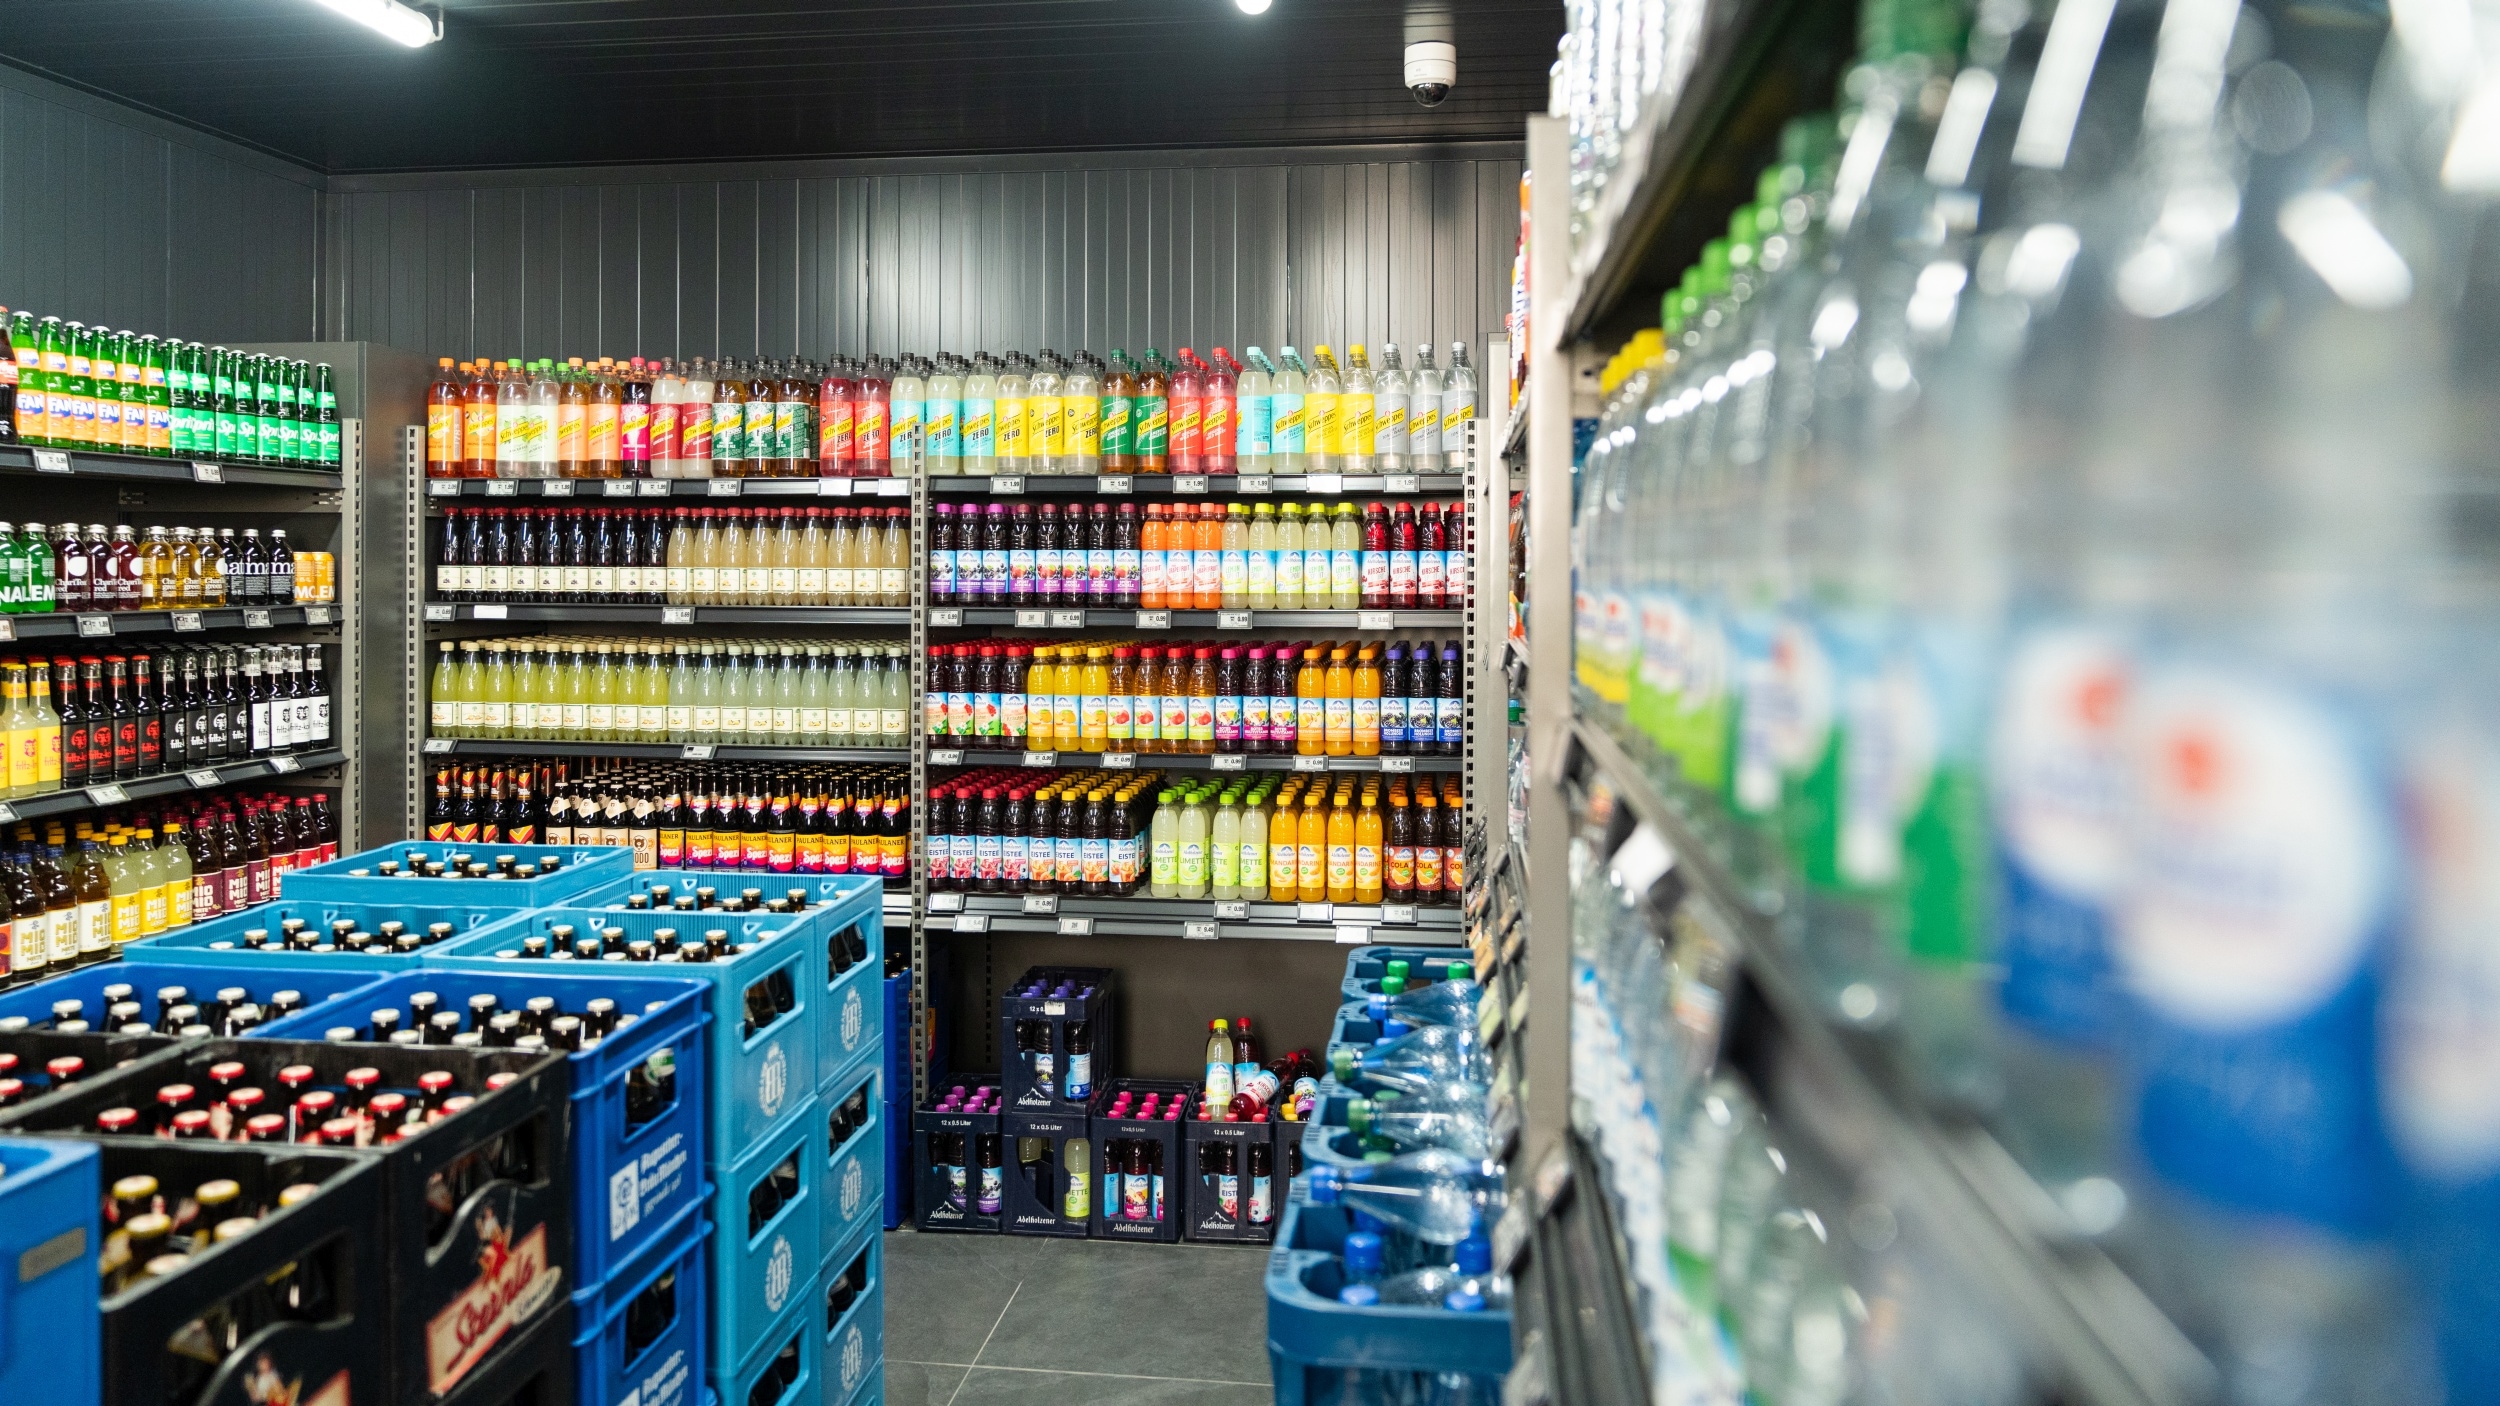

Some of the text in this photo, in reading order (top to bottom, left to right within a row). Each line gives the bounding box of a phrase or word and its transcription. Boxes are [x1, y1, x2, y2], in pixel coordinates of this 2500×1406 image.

[935, 428, 952, 441] ZERO
[972, 427, 989, 441] ZERO
[1004, 428, 1020, 442] ZERO
[1045, 426, 1060, 438] ZERO
[718, 846, 740, 860] Spezi
[769, 849, 792, 865] Spezi
[824, 850, 848, 867] Spezi
[882, 851, 905, 868] Spezi
[21, 929, 45, 943] MIO
[21, 942, 45, 957] MIO
[1017, 1097, 1052, 1107] Adelholzener
[1016, 1215, 1056, 1225] Adelholzener
[1200, 1220, 1236, 1230] Adelholzener
[1112, 1223, 1155, 1233] Adelholzener
